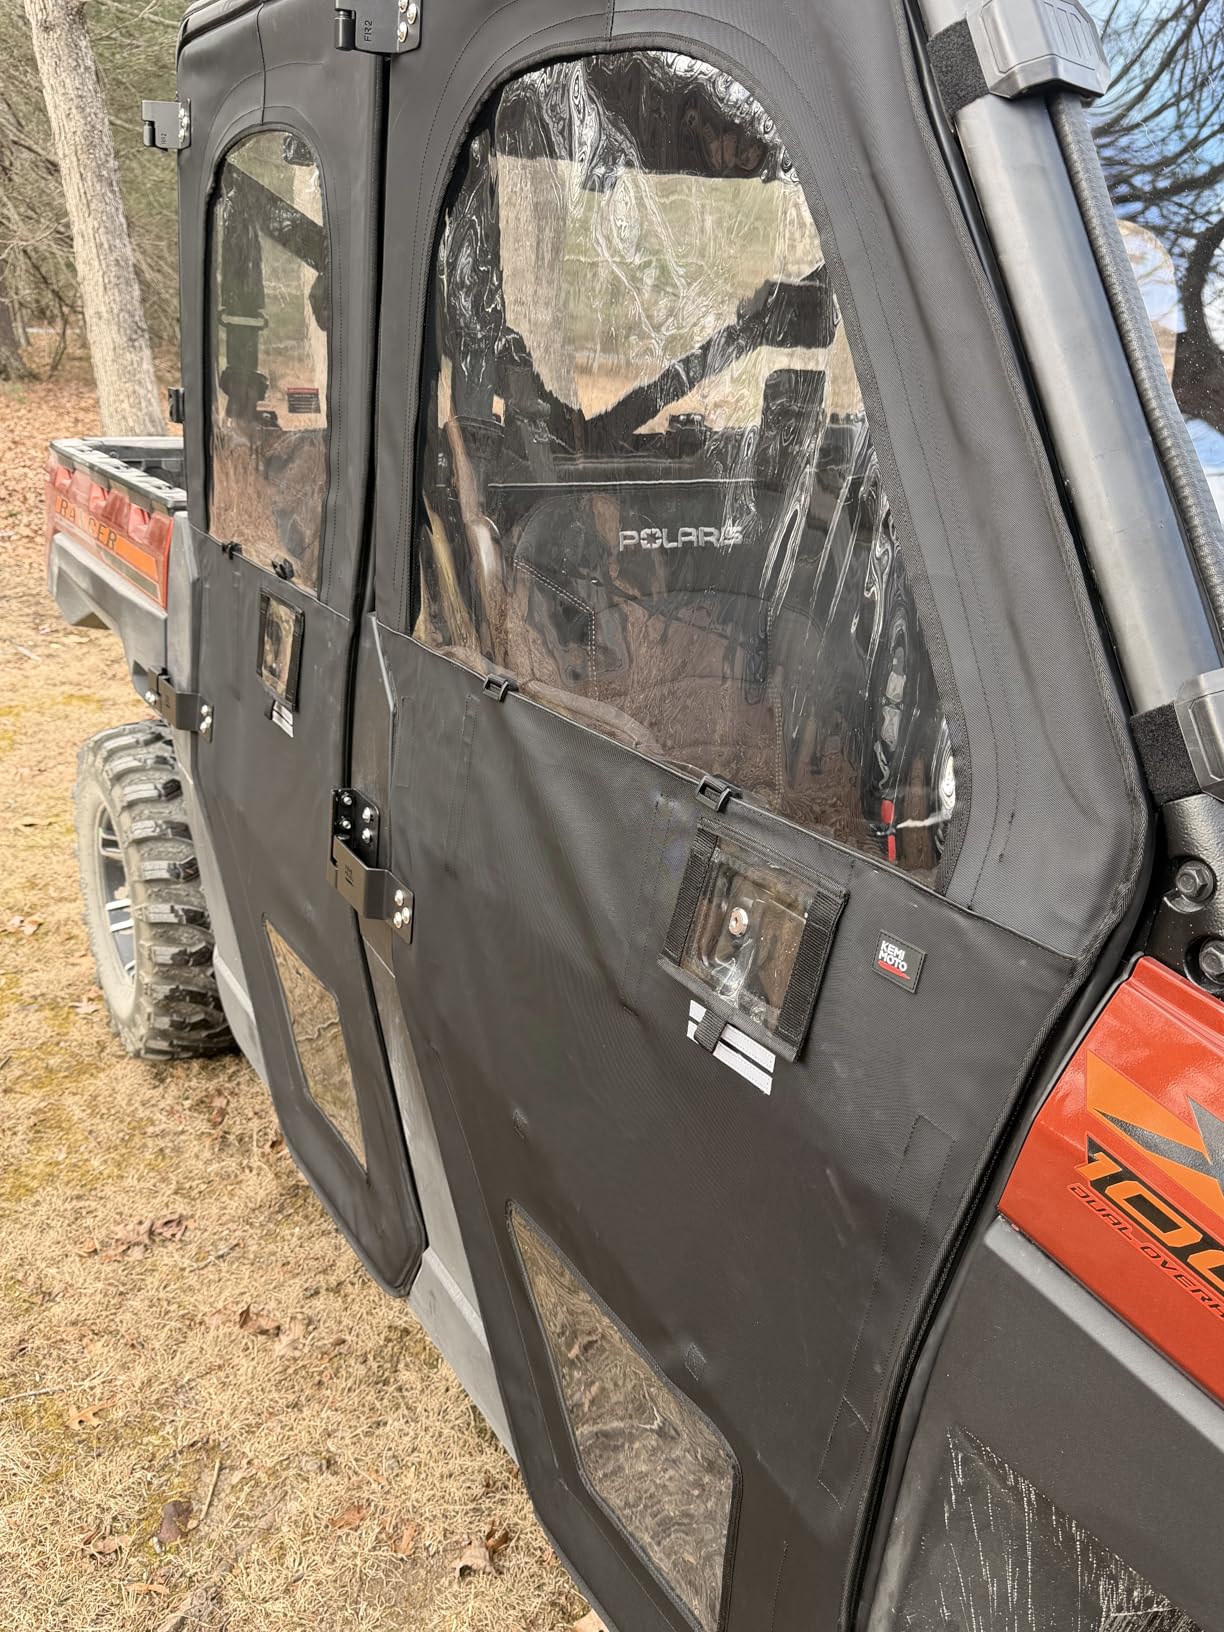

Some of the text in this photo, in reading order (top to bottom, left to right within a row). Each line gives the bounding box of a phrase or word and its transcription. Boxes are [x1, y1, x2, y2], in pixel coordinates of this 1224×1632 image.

[878, 950, 908, 972] MOTO
[880, 940, 906, 960] KEMI
[1069, 1185, 1132, 1241] DUAL
